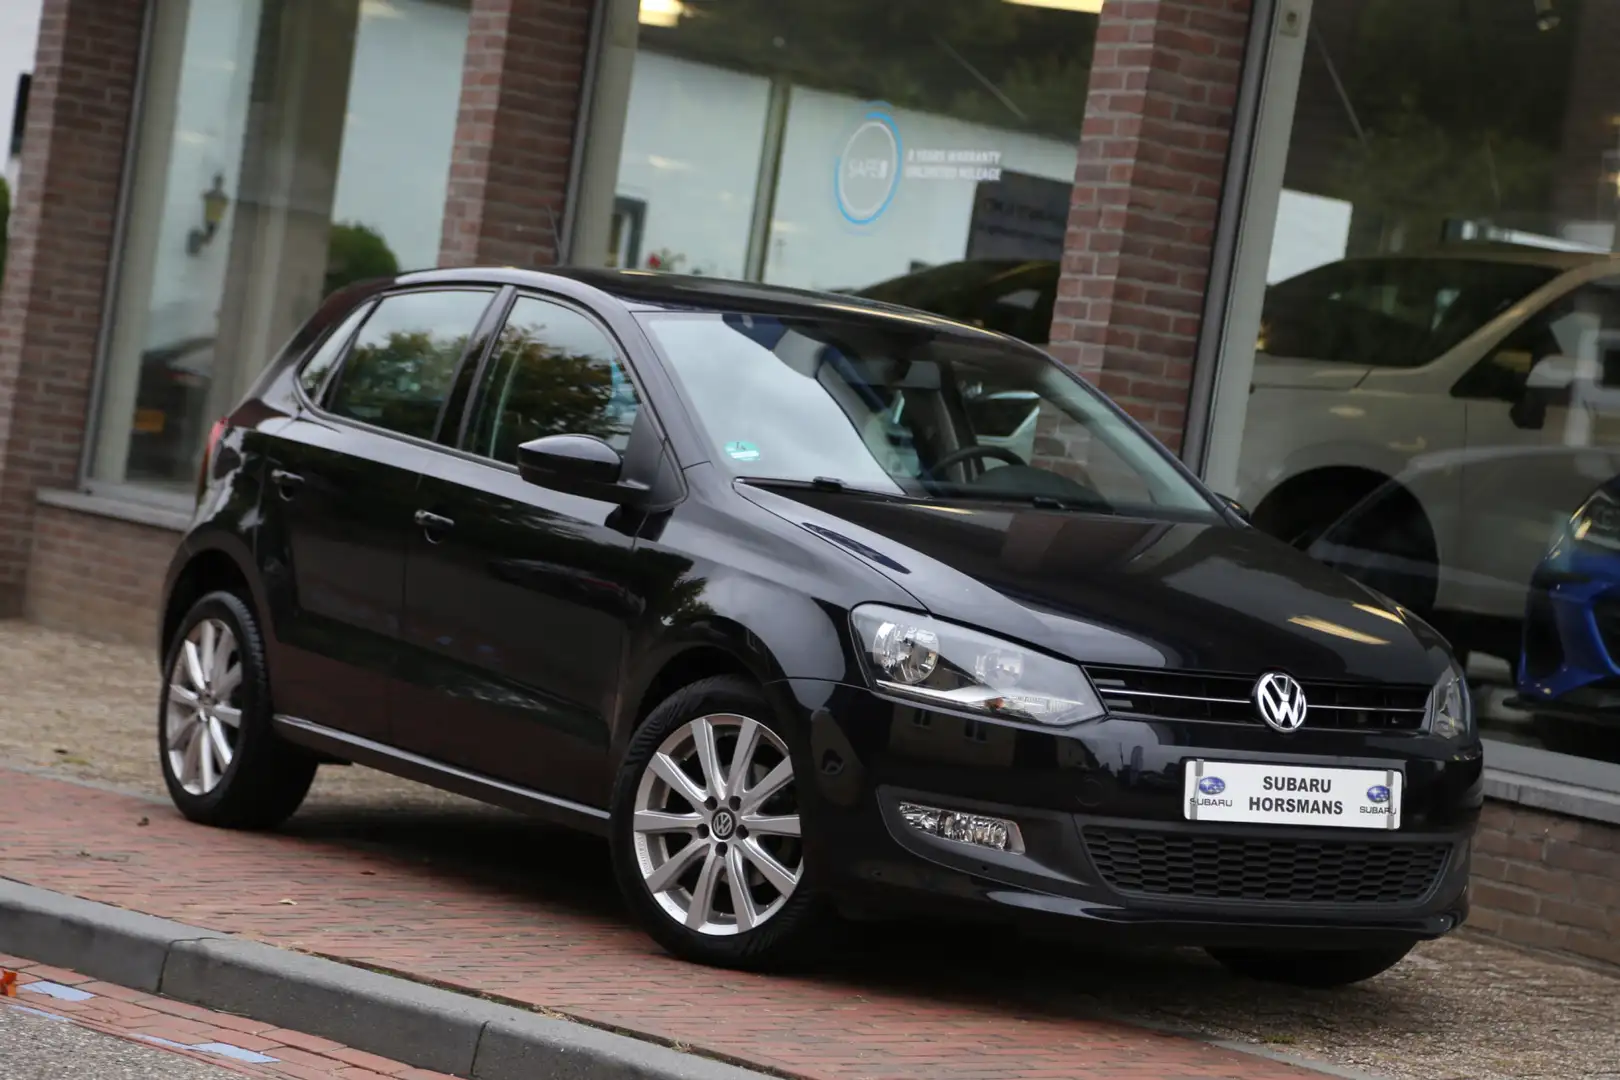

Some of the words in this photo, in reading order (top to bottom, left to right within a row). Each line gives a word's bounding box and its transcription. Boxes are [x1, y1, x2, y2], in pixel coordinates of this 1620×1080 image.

[947, 150, 1002, 164] WARRANTY
[1263, 776, 1332, 793] SUBARU
[1189, 797, 1233, 808] SUBARU
[1249, 796, 1343, 815] HORSMANS
[1359, 805, 1397, 815] SUBARU
